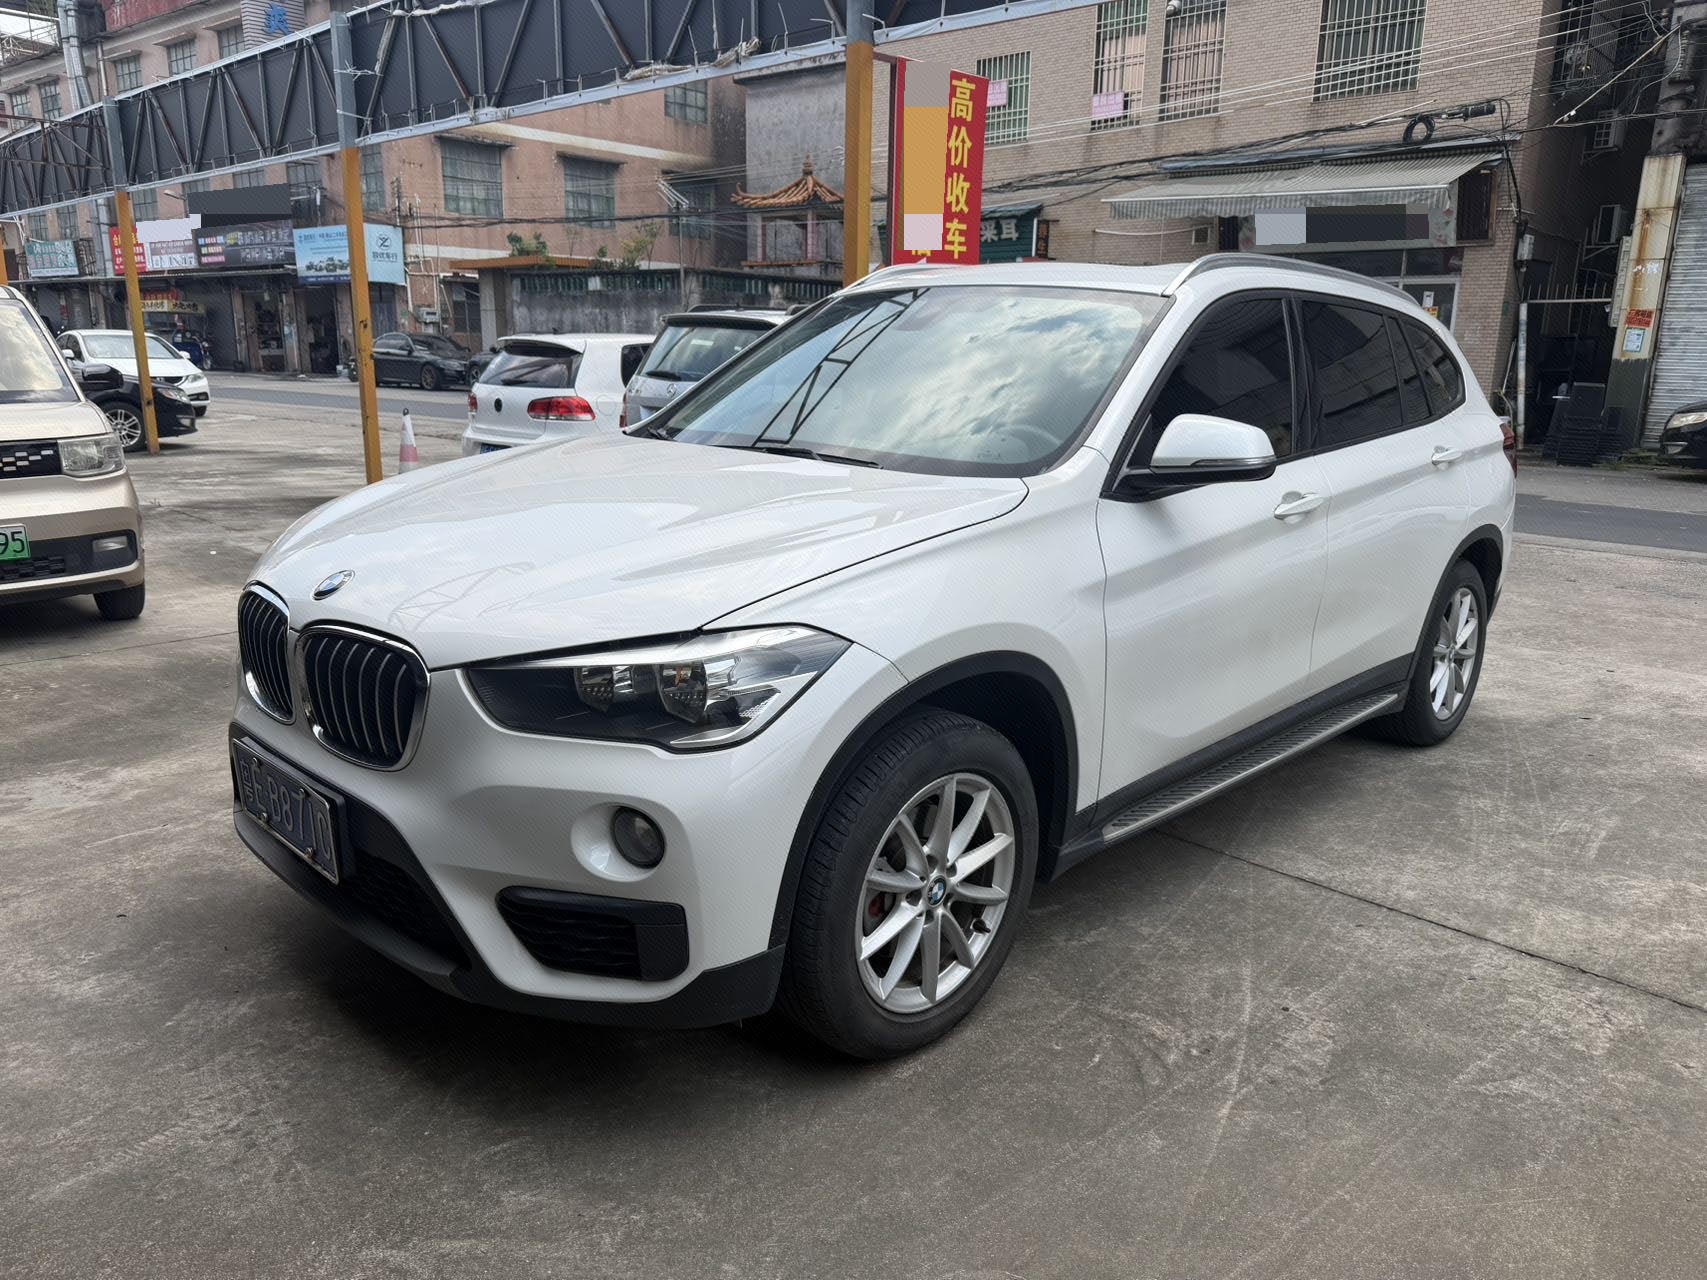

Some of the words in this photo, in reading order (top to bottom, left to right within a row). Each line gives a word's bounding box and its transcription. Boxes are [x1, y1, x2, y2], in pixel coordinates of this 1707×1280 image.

[944, 78, 976, 260] 高价收车
[980, 218, 1019, 243] 采耳
[0, 531, 25, 554] 95
